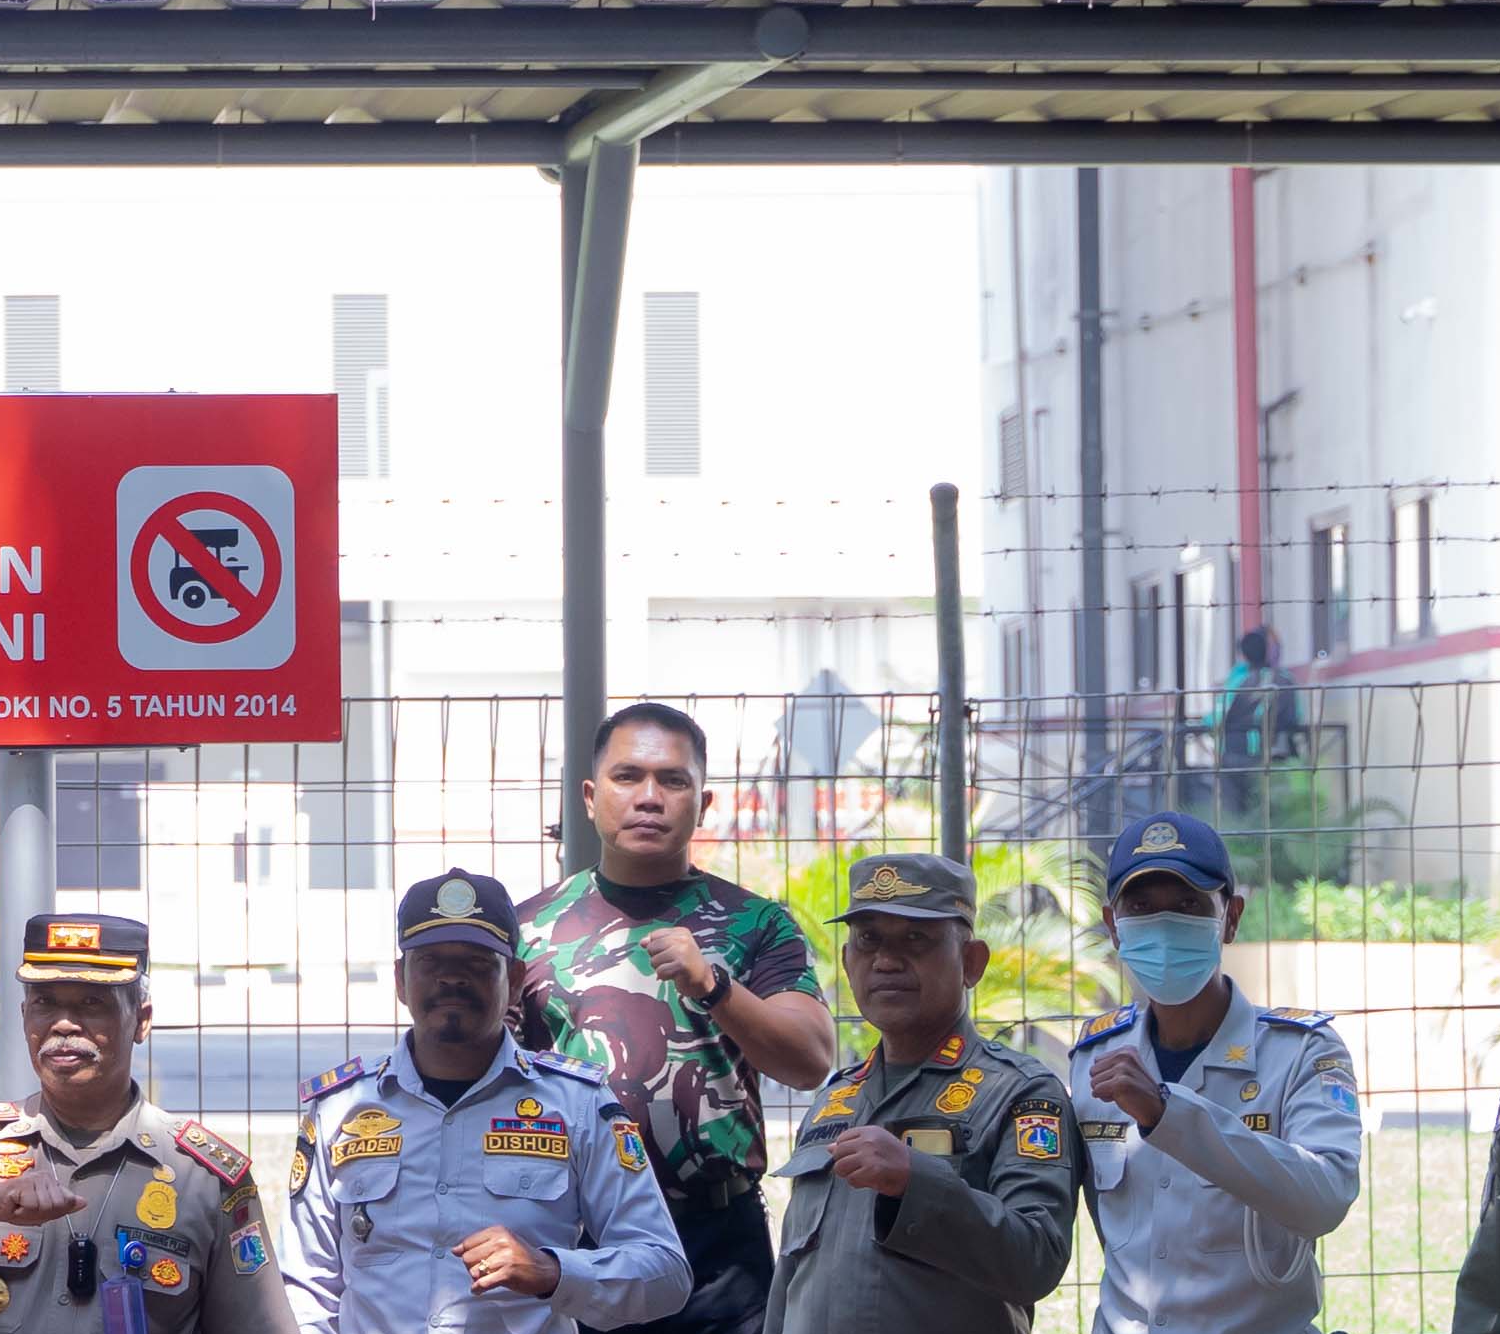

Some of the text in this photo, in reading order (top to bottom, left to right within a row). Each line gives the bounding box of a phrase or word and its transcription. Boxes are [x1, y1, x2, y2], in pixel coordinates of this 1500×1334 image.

[48, 694, 98, 719] NO.
[106, 695, 123, 719] 5
[129, 694, 226, 718] TAHUN
[234, 693, 298, 717] 2014
[488, 1135, 565, 1154] DISHUB
